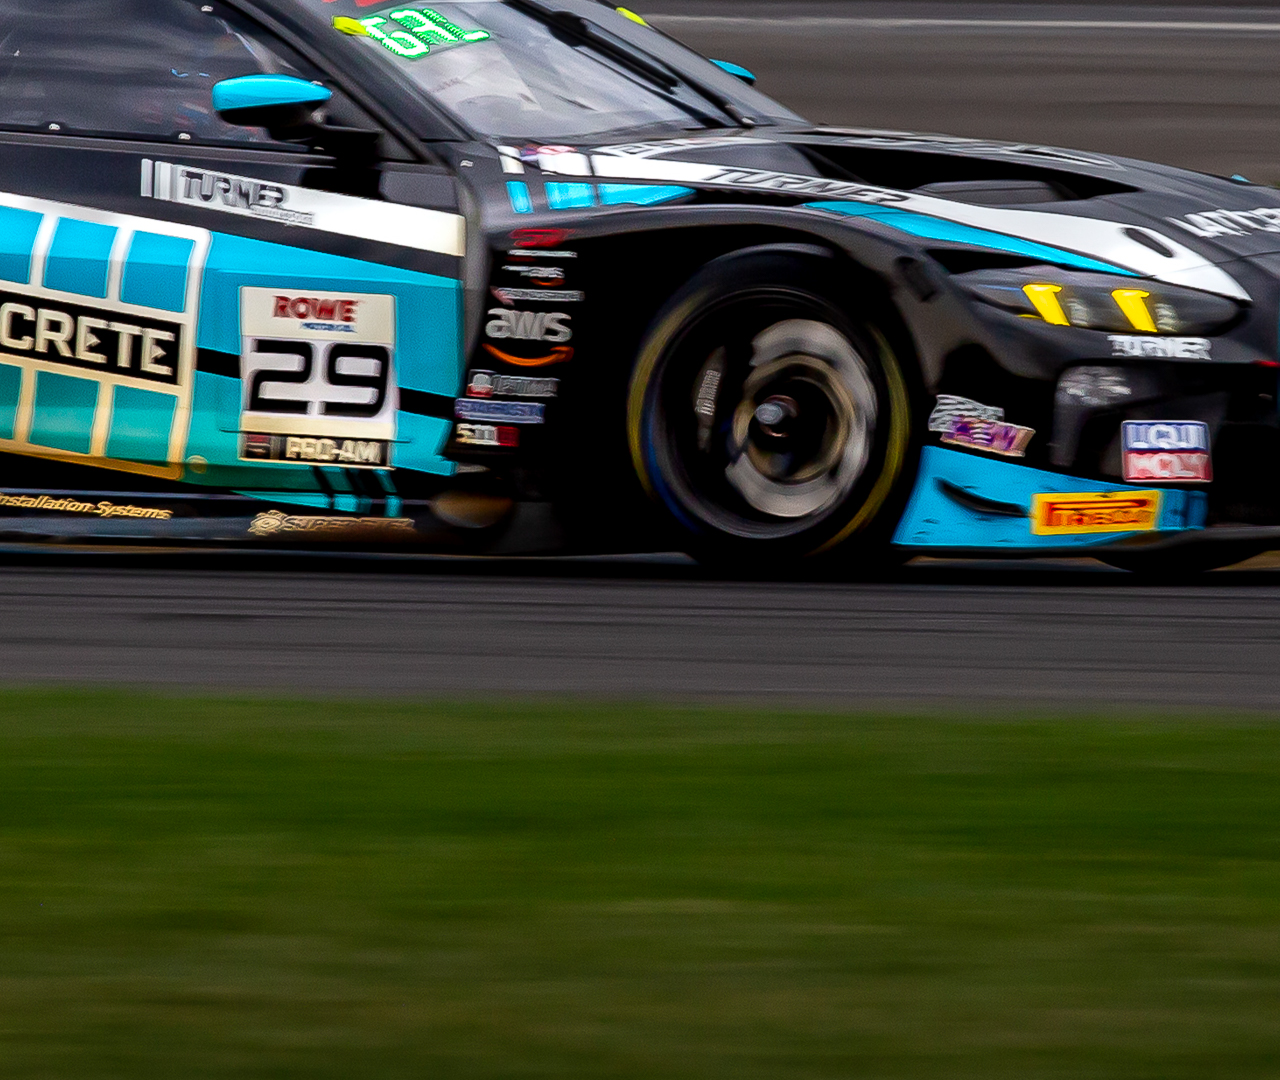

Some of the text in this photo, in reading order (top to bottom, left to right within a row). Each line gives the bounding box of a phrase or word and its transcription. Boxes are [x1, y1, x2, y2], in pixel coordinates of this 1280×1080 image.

[272, 295, 359, 323] ROWE
[485, 308, 572, 342] aws
[248, 338, 390, 418] 29
[95, 500, 174, 521] Systems
